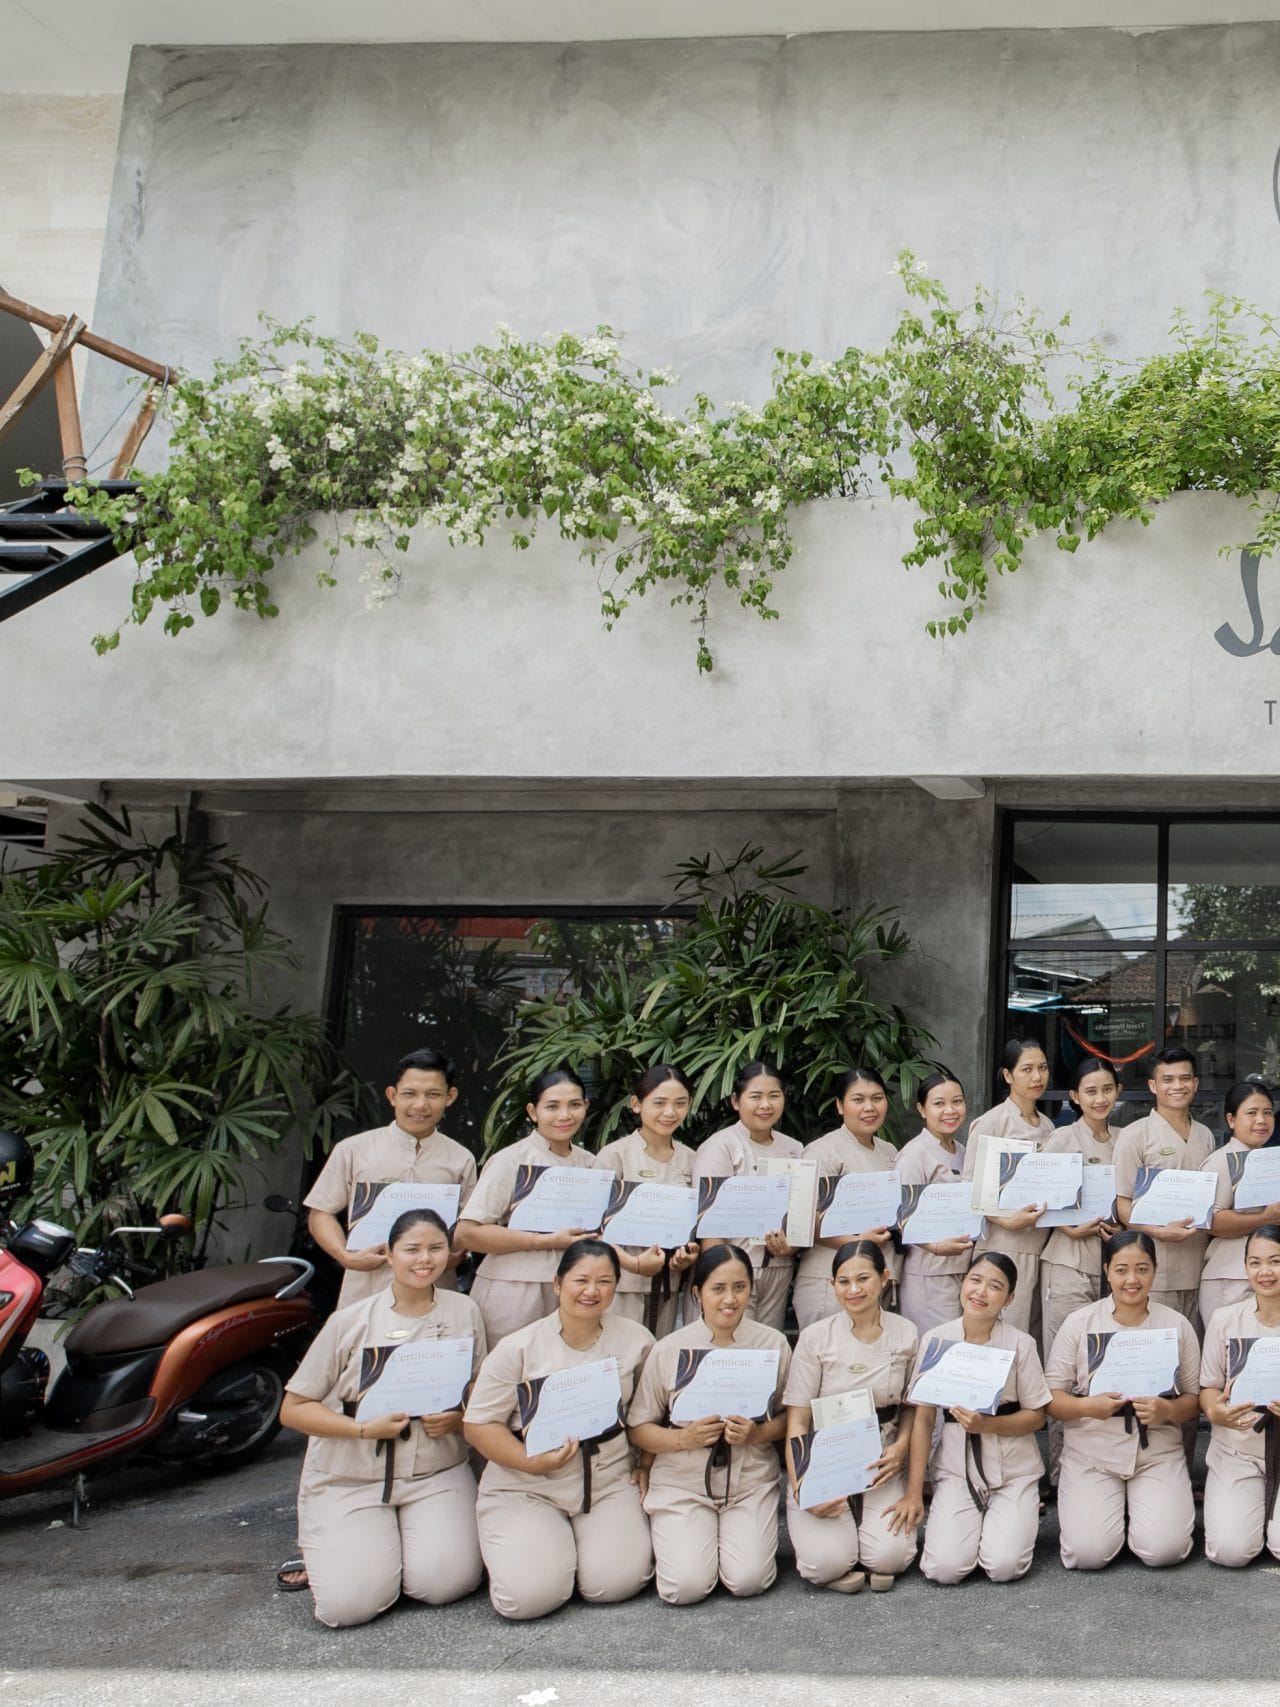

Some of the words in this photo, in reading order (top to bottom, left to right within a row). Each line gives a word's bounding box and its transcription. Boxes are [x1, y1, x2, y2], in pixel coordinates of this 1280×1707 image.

[391, 1350, 446, 1361] Certificate
[704, 1356, 753, 1367] Certificate
[543, 1373, 593, 1393] Certificate
